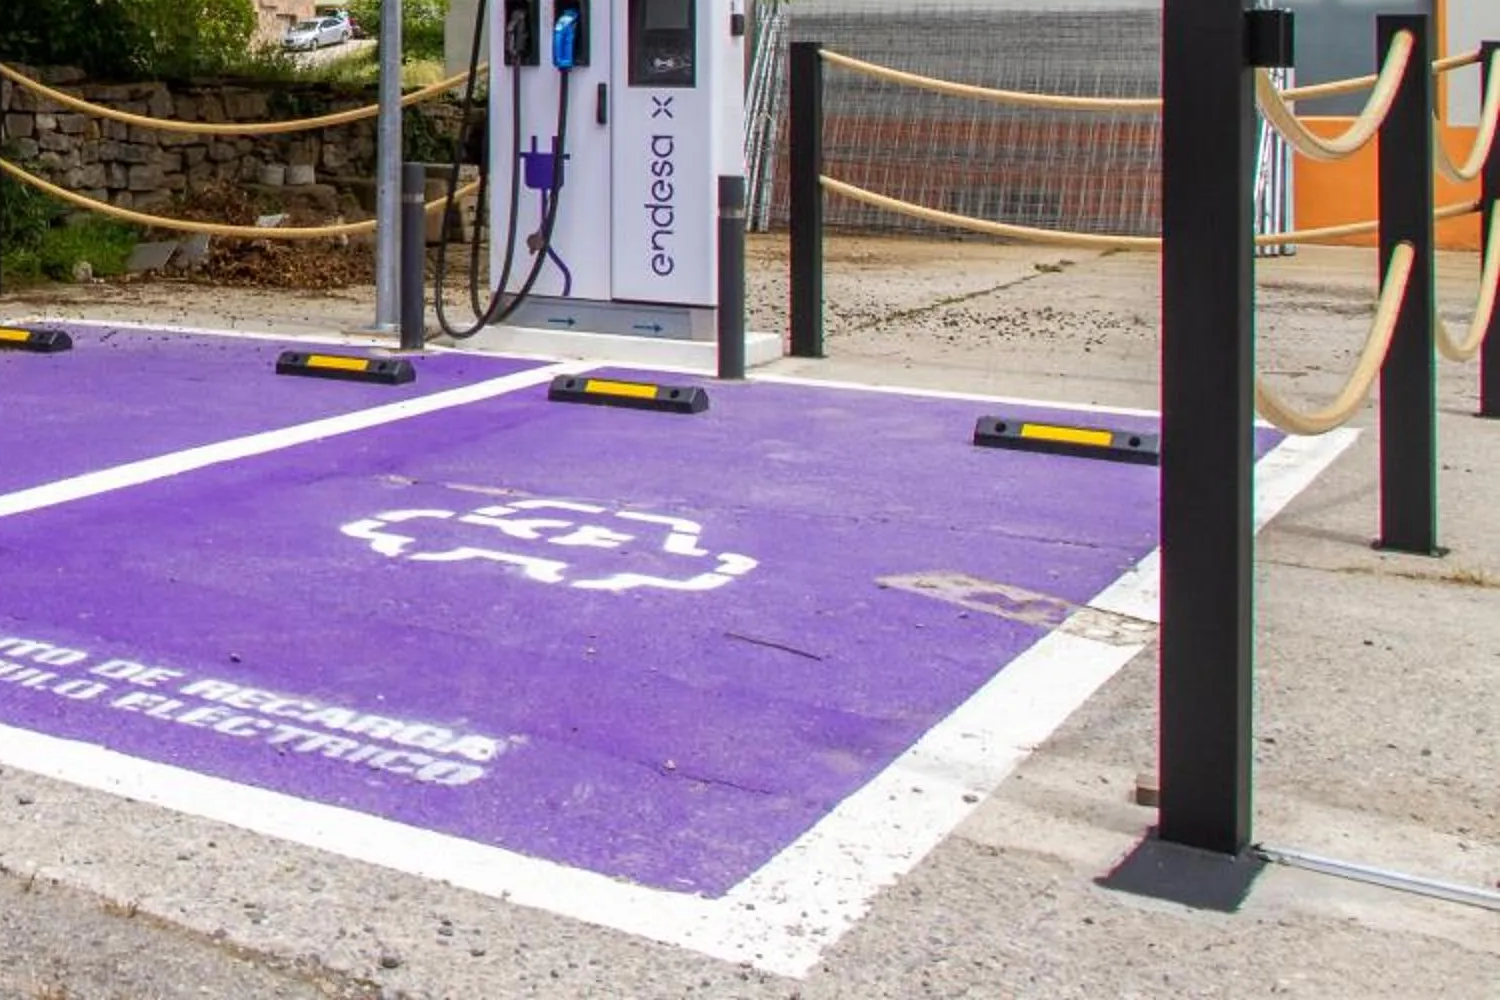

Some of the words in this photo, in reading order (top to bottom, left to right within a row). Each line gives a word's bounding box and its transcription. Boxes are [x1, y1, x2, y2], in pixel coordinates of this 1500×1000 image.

[644, 134, 675, 277] endesa
[90, 659, 185, 687] DE
[180, 678, 505, 761] RECARGA
